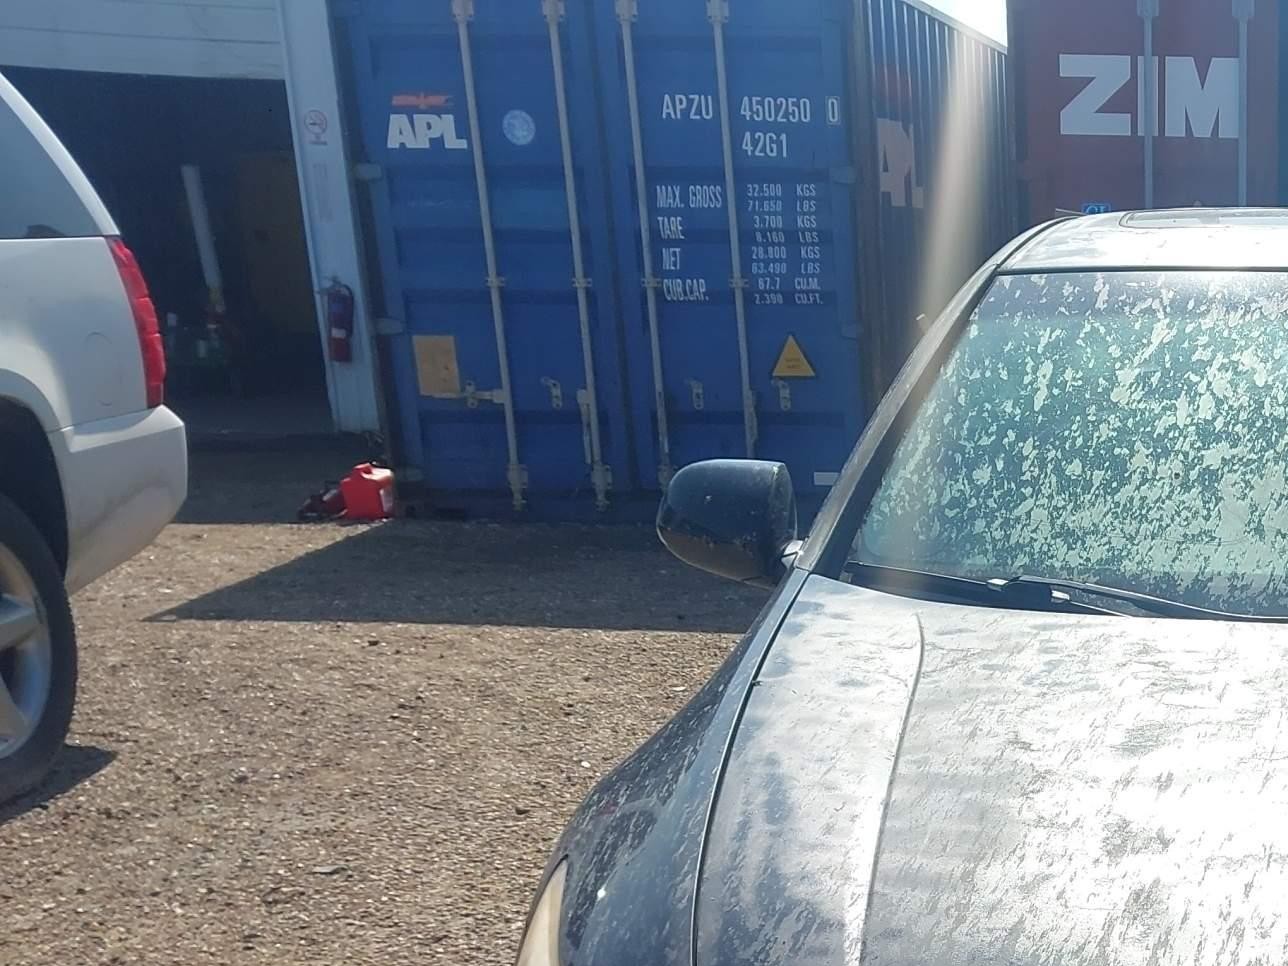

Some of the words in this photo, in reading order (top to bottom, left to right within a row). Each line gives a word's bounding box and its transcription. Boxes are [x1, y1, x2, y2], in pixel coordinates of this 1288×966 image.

[1058, 53, 1240, 139] ZIM
[662, 94, 713, 119] APZU
[740, 96, 811, 122] 450250
[828, 98, 838, 122] 0
[387, 113, 468, 149] APL
[742, 131, 787, 158] 42G1
[656, 185, 684, 209] MAX.
[689, 185, 722, 209] GROSS
[746, 183, 782, 197] 32.500
[796, 183, 816, 197] KGS
[796, 199, 816, 212] LBS
[657, 216, 685, 239] TARE
[753, 215, 783, 228] 3.700
[797, 215, 817, 228] KGS
[798, 231, 819, 243] LBS
[662, 248, 681, 270] NET
[800, 246, 820, 259] KGS
[801, 262, 820, 274] LBS
[758, 277, 780, 290] 67.7
